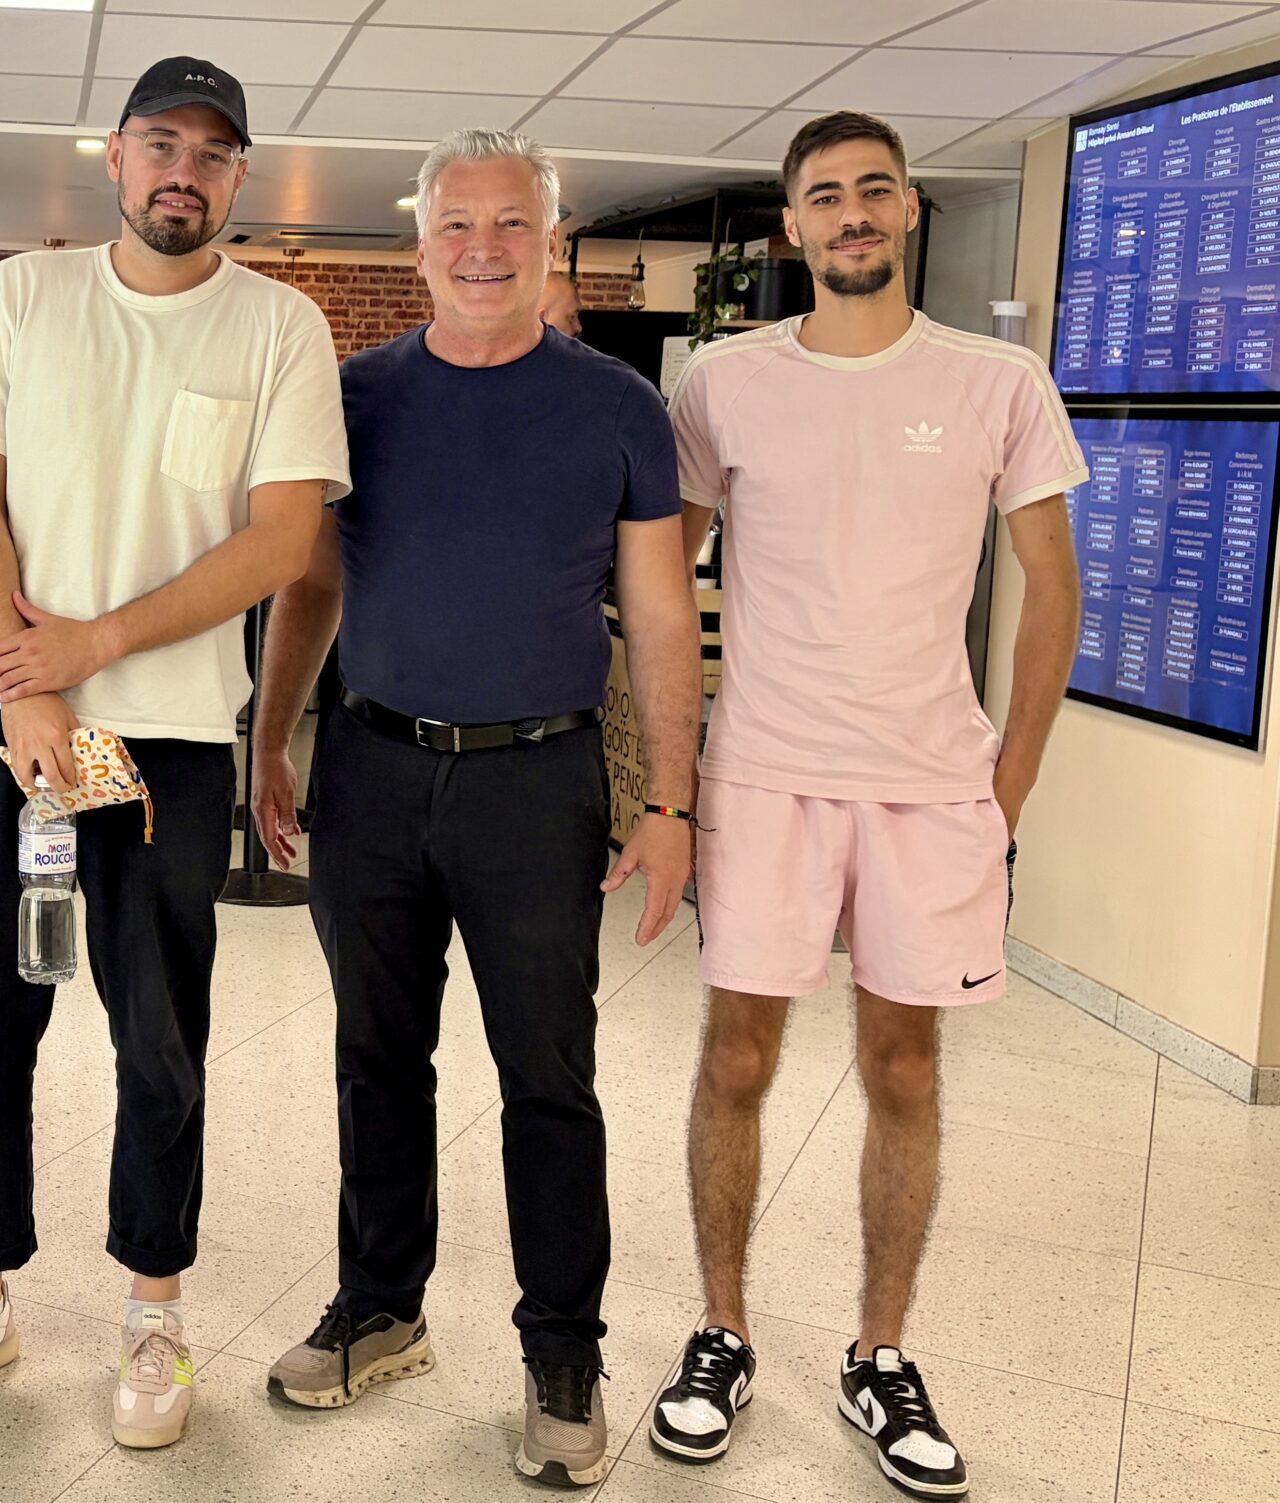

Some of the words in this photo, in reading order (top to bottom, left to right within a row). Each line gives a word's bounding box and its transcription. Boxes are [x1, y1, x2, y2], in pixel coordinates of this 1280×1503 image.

[1181, 115, 1191, 125] Les
[1191, 108, 1219, 122] Praticiens
[1220, 106, 1228, 116] de
[903, 443, 942, 454] adidas
[604, 720, 643, 766] GOÏSTE
[35, 852, 76, 867] ROUCOU
